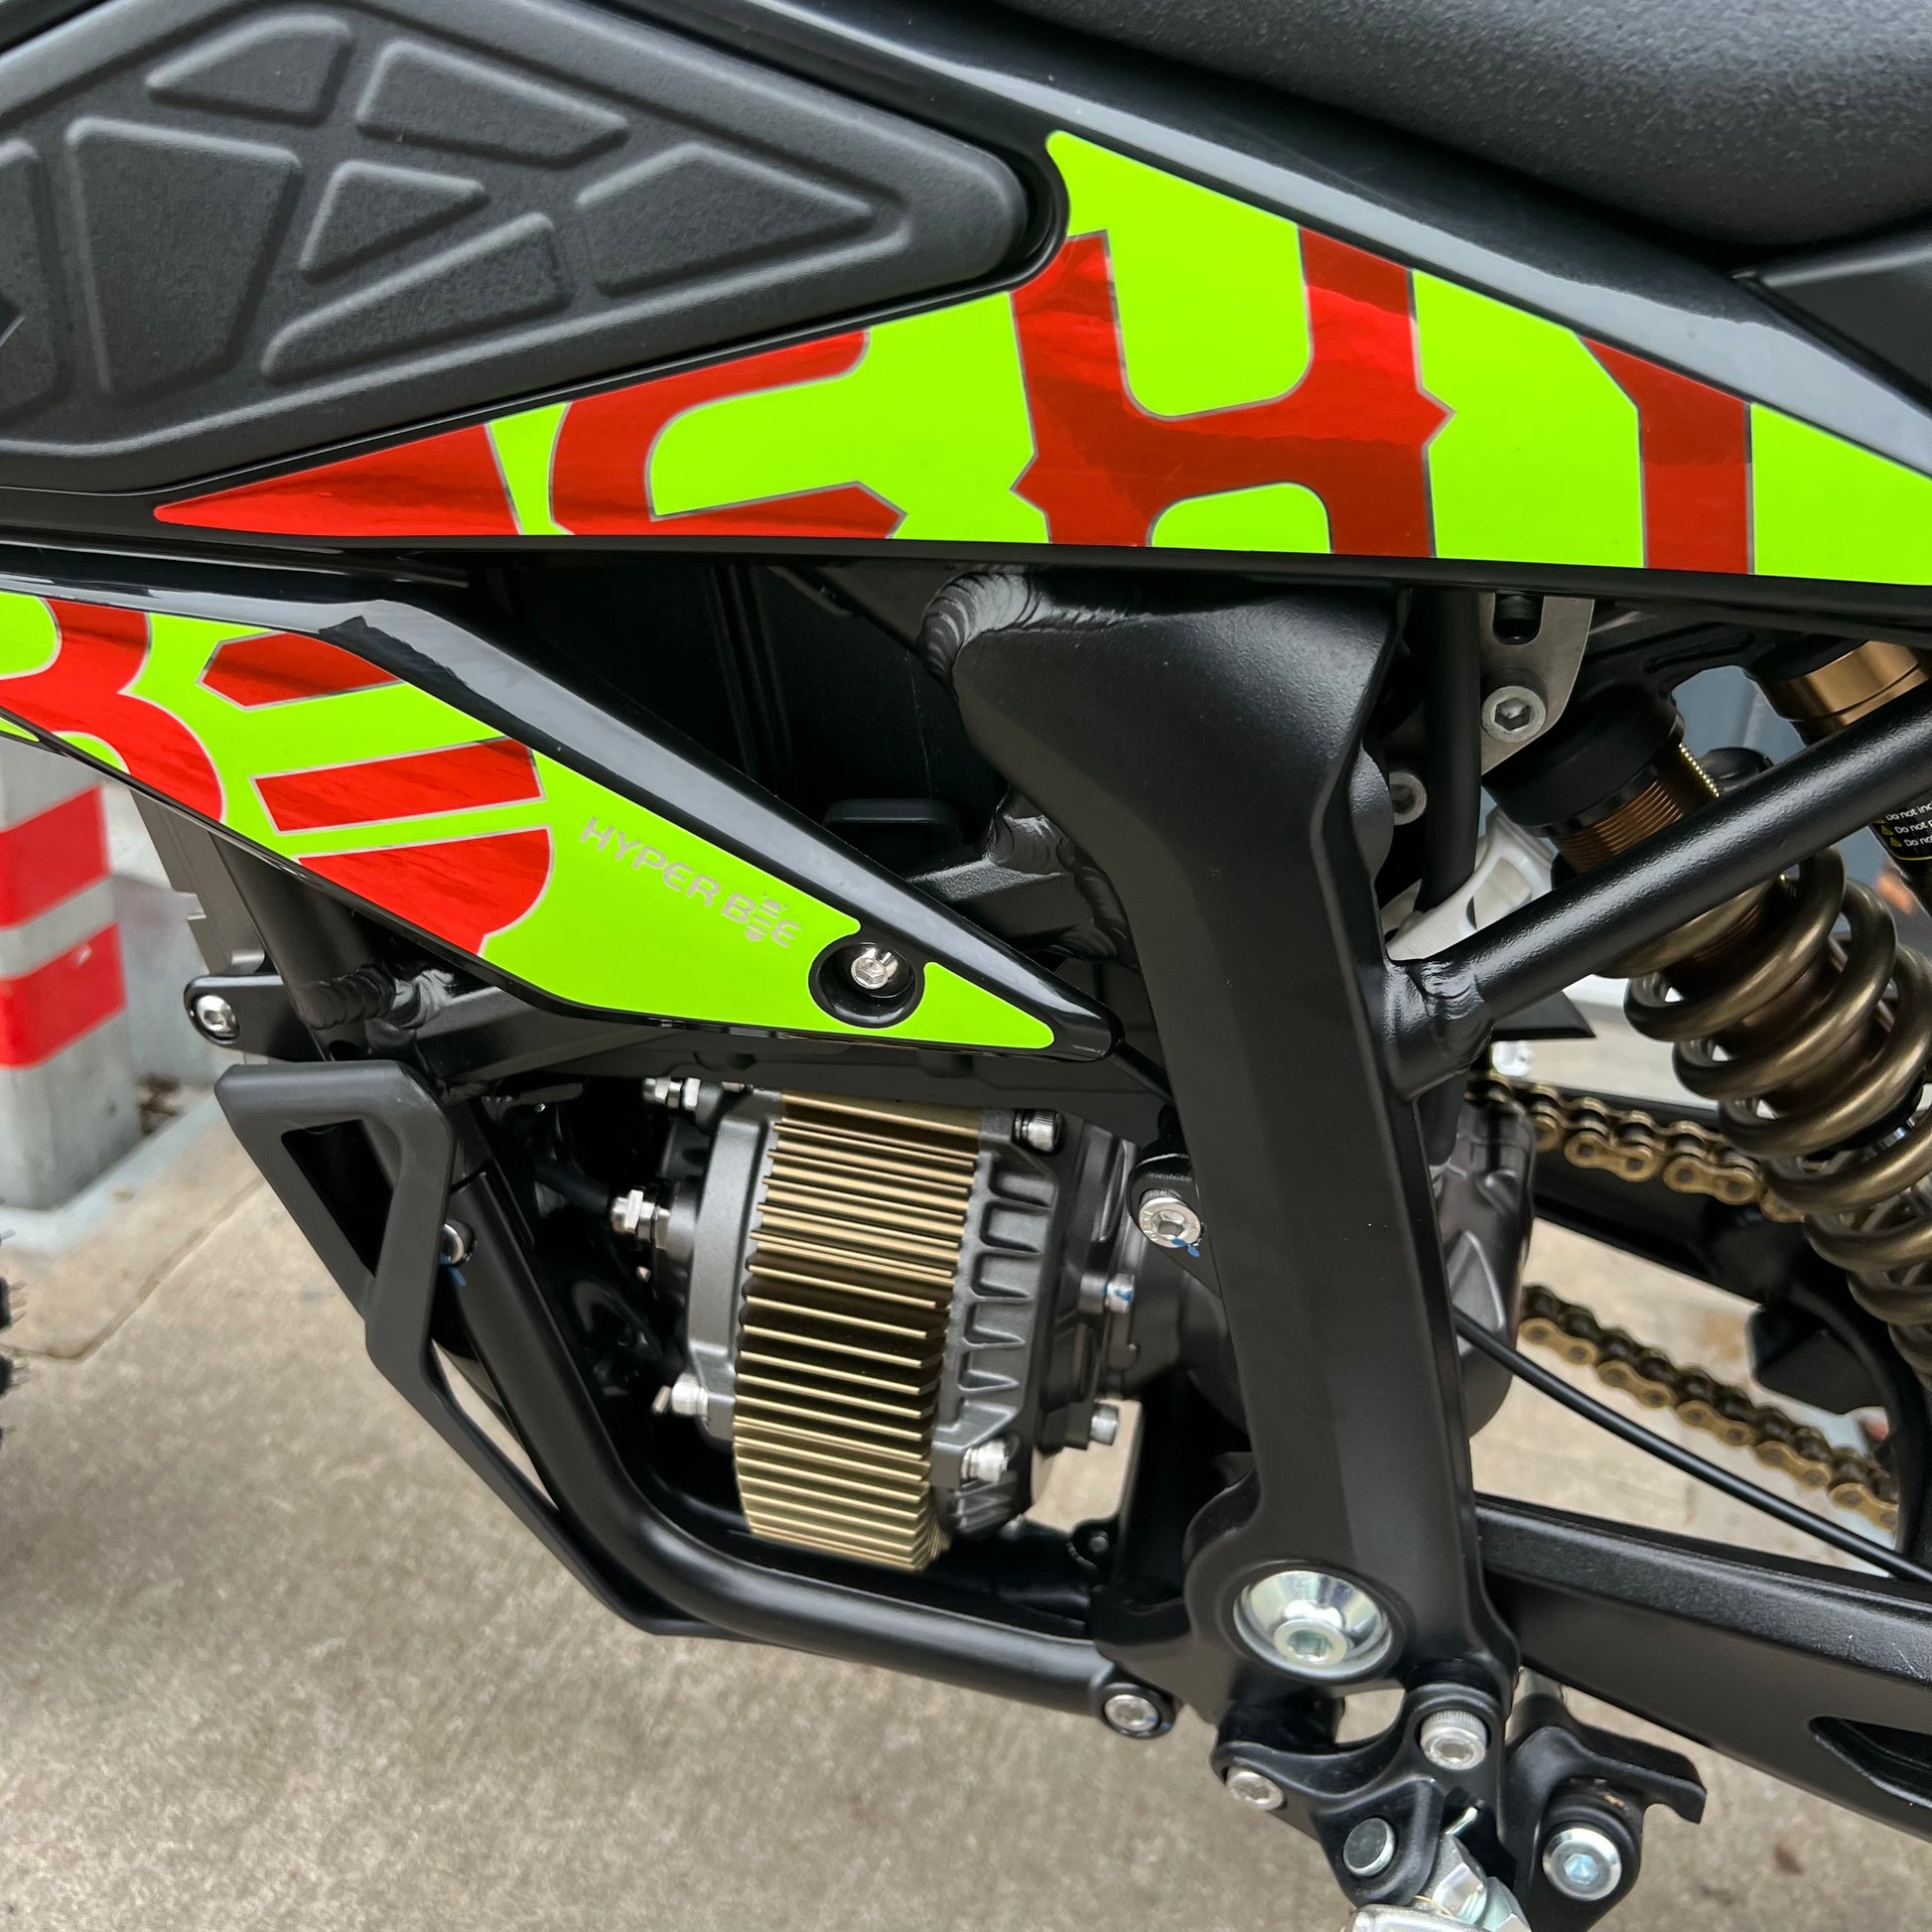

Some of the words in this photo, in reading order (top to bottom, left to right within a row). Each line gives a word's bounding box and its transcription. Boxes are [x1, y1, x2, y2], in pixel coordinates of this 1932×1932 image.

[1899, 809, 1918, 818] not
[1909, 822, 1928, 831] not
[580, 816, 721, 906] HYPER
